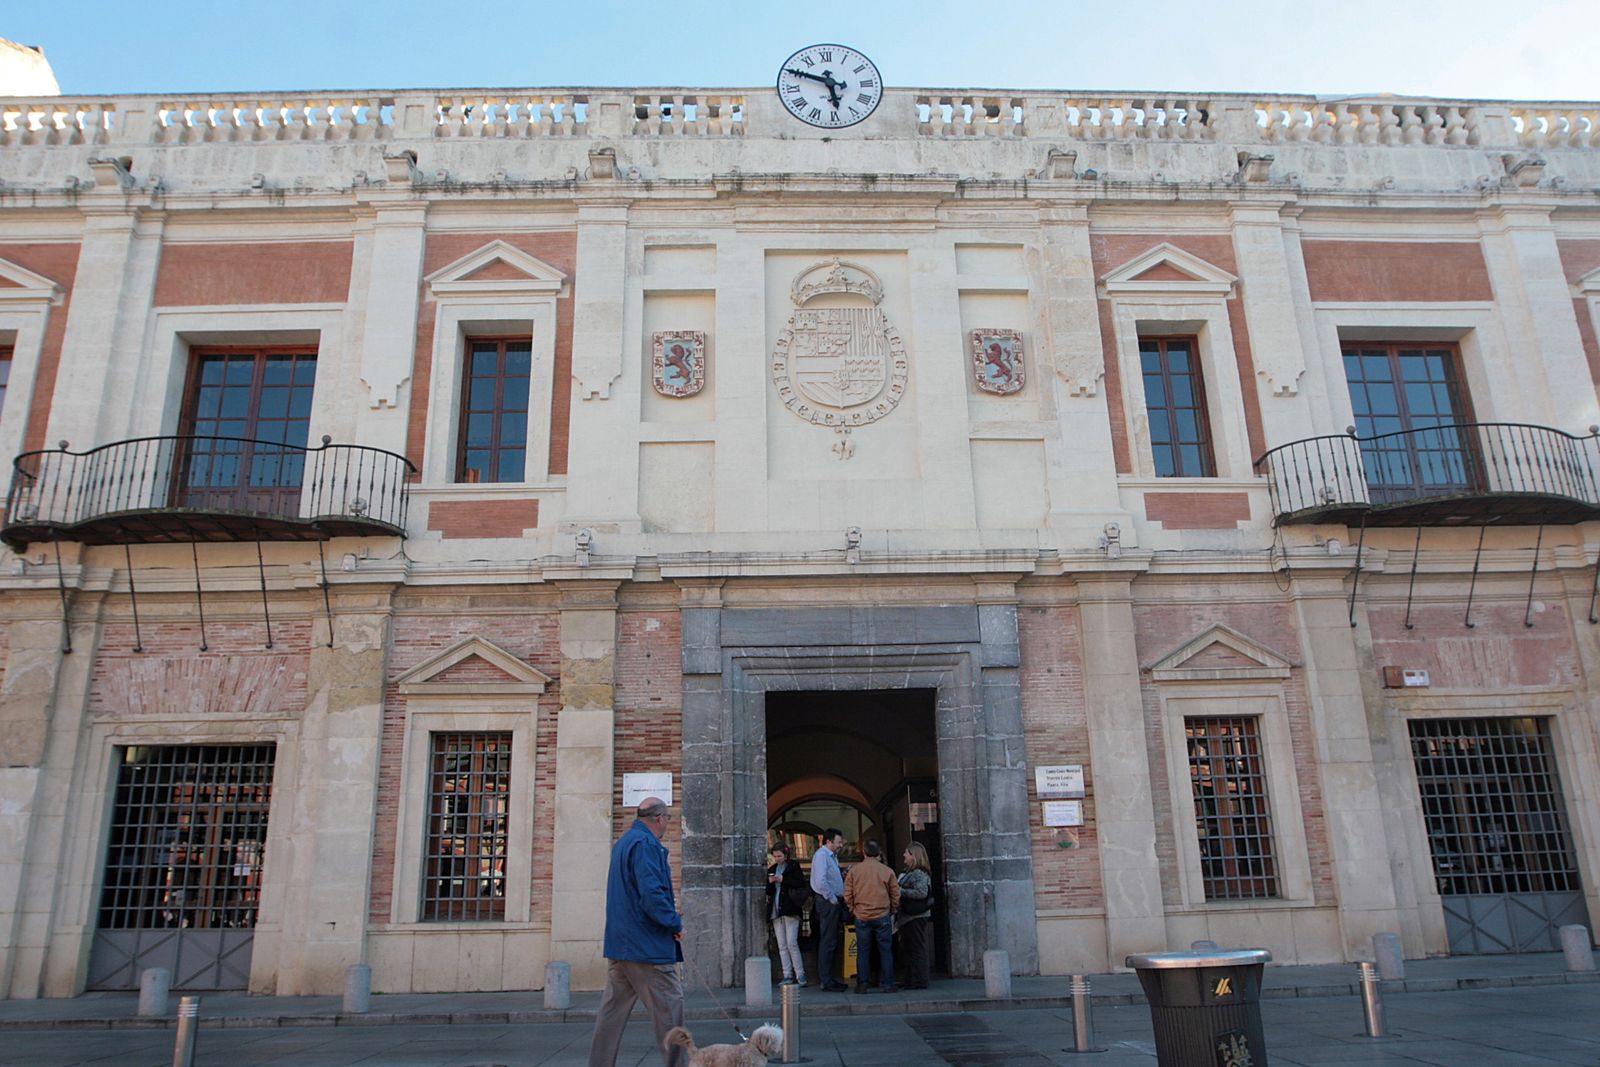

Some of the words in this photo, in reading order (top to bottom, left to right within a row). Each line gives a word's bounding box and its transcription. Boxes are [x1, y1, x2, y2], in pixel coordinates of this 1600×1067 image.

[801, 55, 815, 68] XI
[819, 51, 832, 63] XII
[853, 64, 866, 74] II
[786, 84, 800, 93] IX
[859, 79, 873, 88] III
[791, 96, 808, 111] VIII
[856, 93, 872, 106] IIII
[808, 107, 821, 121] VII
[830, 111, 840, 122] VI
[848, 106, 859, 117] V
